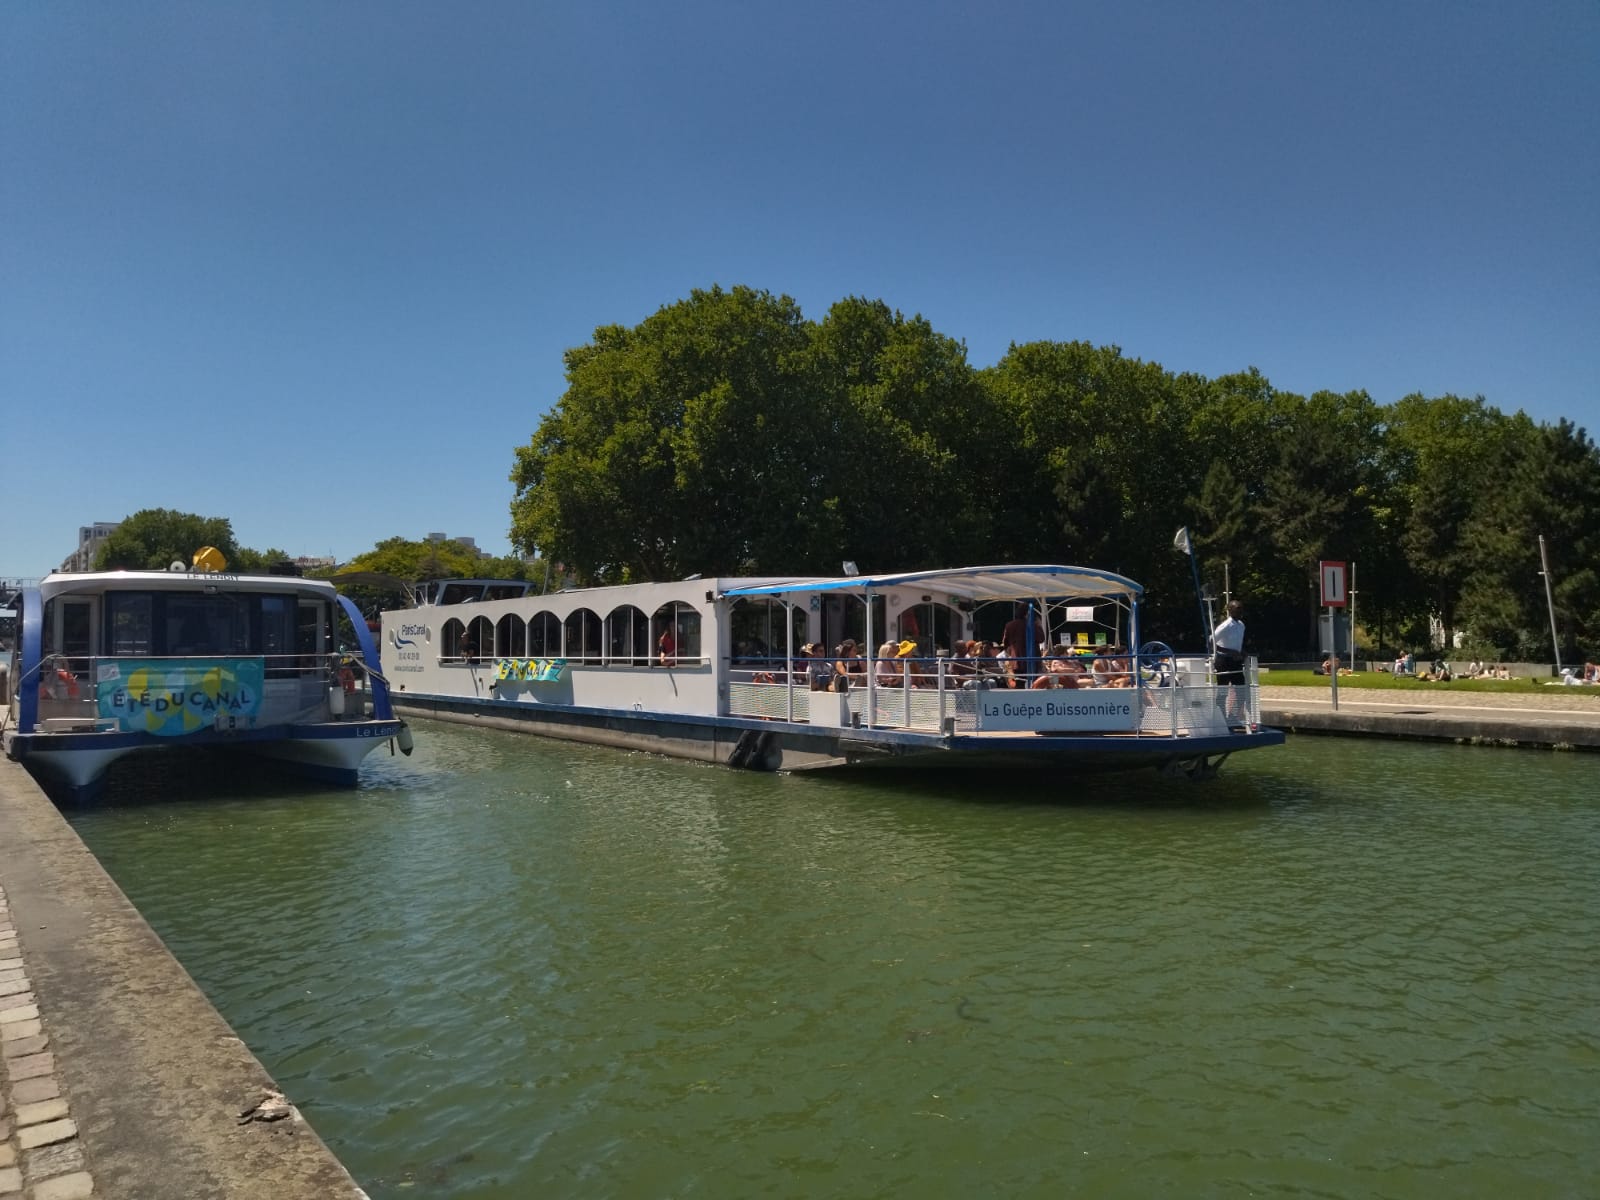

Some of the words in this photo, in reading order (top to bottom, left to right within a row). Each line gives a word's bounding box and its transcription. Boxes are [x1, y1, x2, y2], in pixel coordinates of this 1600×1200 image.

[984, 703, 999, 717] La
[1003, 702, 1042, 719] Guêpe
[1046, 701, 1130, 716] Buissonnière
[356, 727, 371, 737] Le
